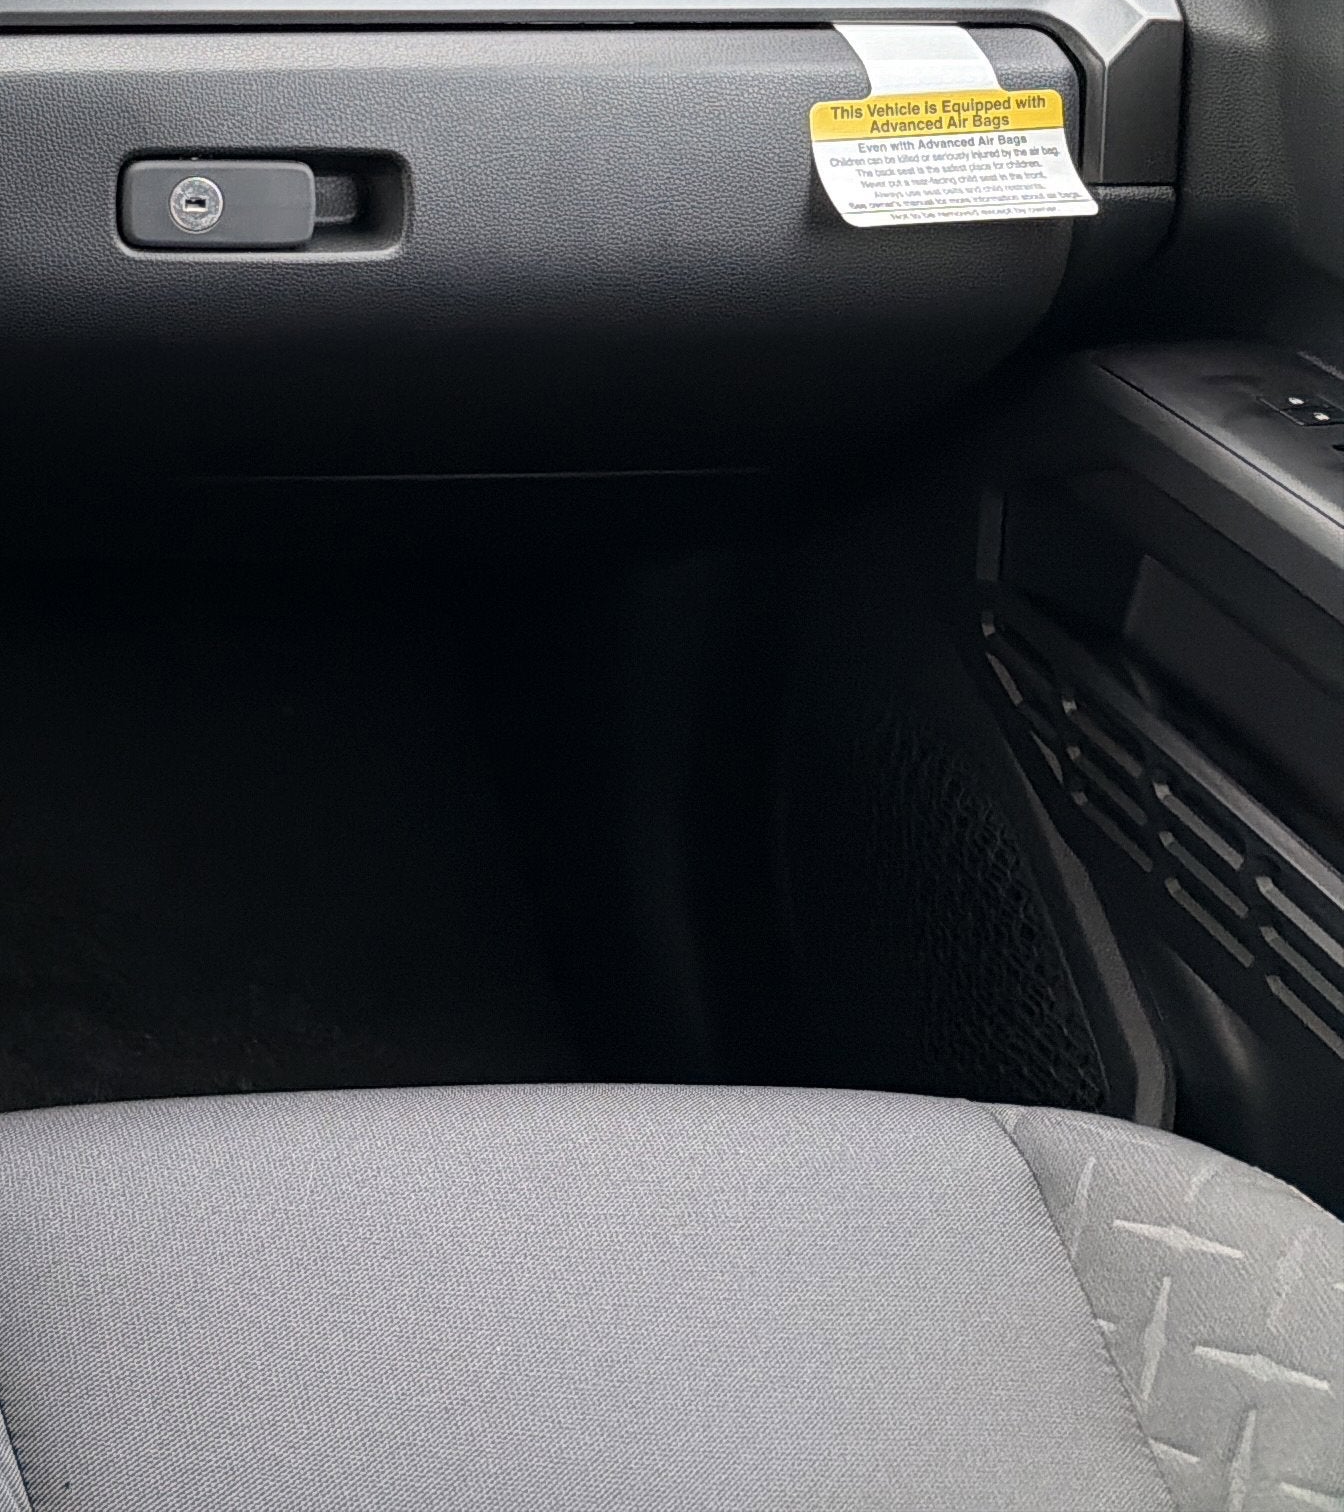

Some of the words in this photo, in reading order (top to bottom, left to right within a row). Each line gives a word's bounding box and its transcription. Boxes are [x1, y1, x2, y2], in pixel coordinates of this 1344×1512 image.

[830, 105, 863, 120] This
[867, 102, 920, 118] Vehicle
[924, 100, 937, 115] is
[941, 97, 1011, 115] Equipped
[1015, 95, 1046, 109] with
[870, 116, 943, 133] Advanced
[947, 115, 969, 129] Air
[972, 114, 1010, 129] Bags
[858, 142, 888, 153] Even
[890, 140, 914, 152] with
[918, 137, 975, 150] Advanced
[978, 135, 994, 146] Air
[997, 134, 1028, 146] Bags
[830, 157, 865, 167] Children
[897, 154, 919, 163] killed
[933, 152, 969, 162] seriously
[971, 149, 1000, 160] injured
[1001, 149, 1012, 159] by
[1013, 148, 1027, 157] the
